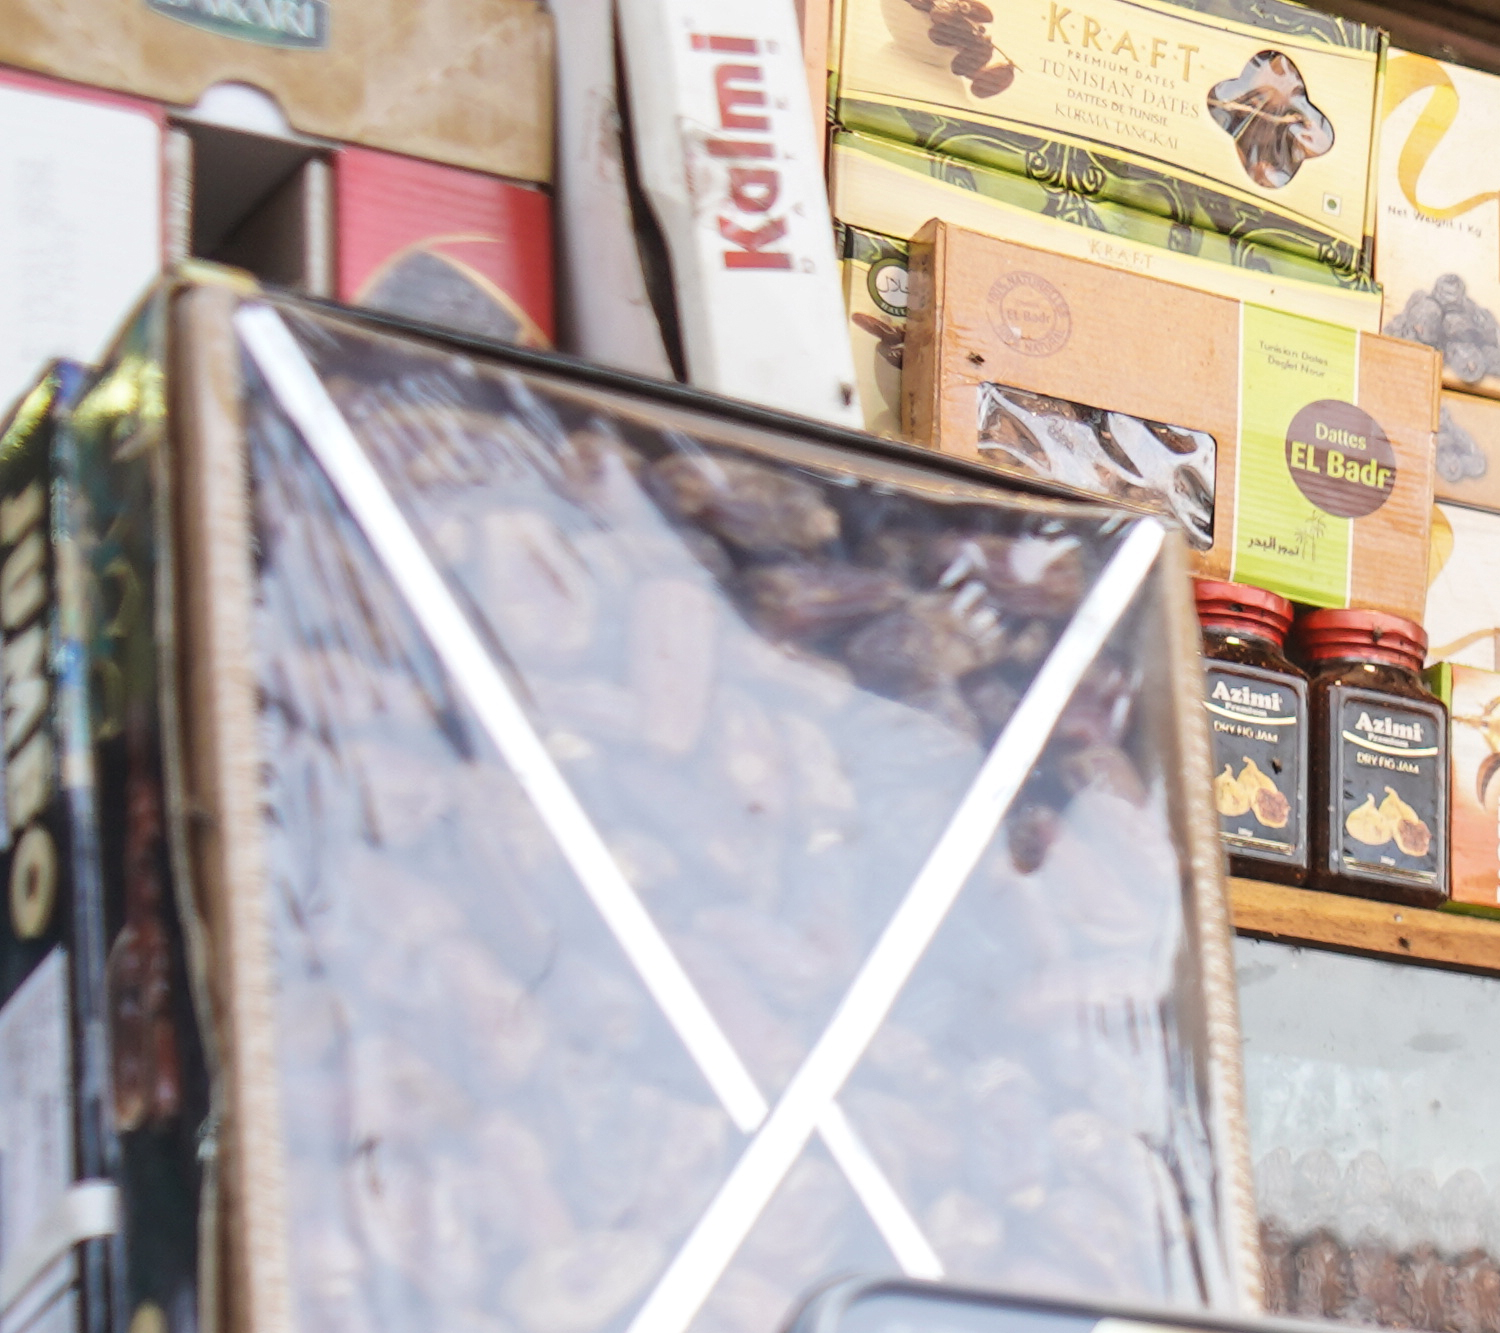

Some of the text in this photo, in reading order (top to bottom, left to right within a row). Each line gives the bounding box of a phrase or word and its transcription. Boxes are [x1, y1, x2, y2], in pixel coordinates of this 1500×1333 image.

[1067, 49, 1175, 90] PREMIUM DATES
[1039, 57, 1200, 119] TUNISIAN DATES
[1066, 87, 1169, 128] DATTES DE TUNISIE
[1055, 103, 1179, 150] KURMA TANGKAI
[1387, 204, 1408, 219] Net
[1413, 210, 1455, 231] Weight
[1315, 422, 1367, 451] Dattes
[1290, 441, 1391, 490] EL Badr
[1211, 680, 1282, 713] Azimi
[1213, 720, 1232, 736] DRY
[1255, 730, 1279, 744] JAM
[1355, 711, 1423, 742] Azimi
[1356, 752, 1420, 775] DRY FIG JAM
